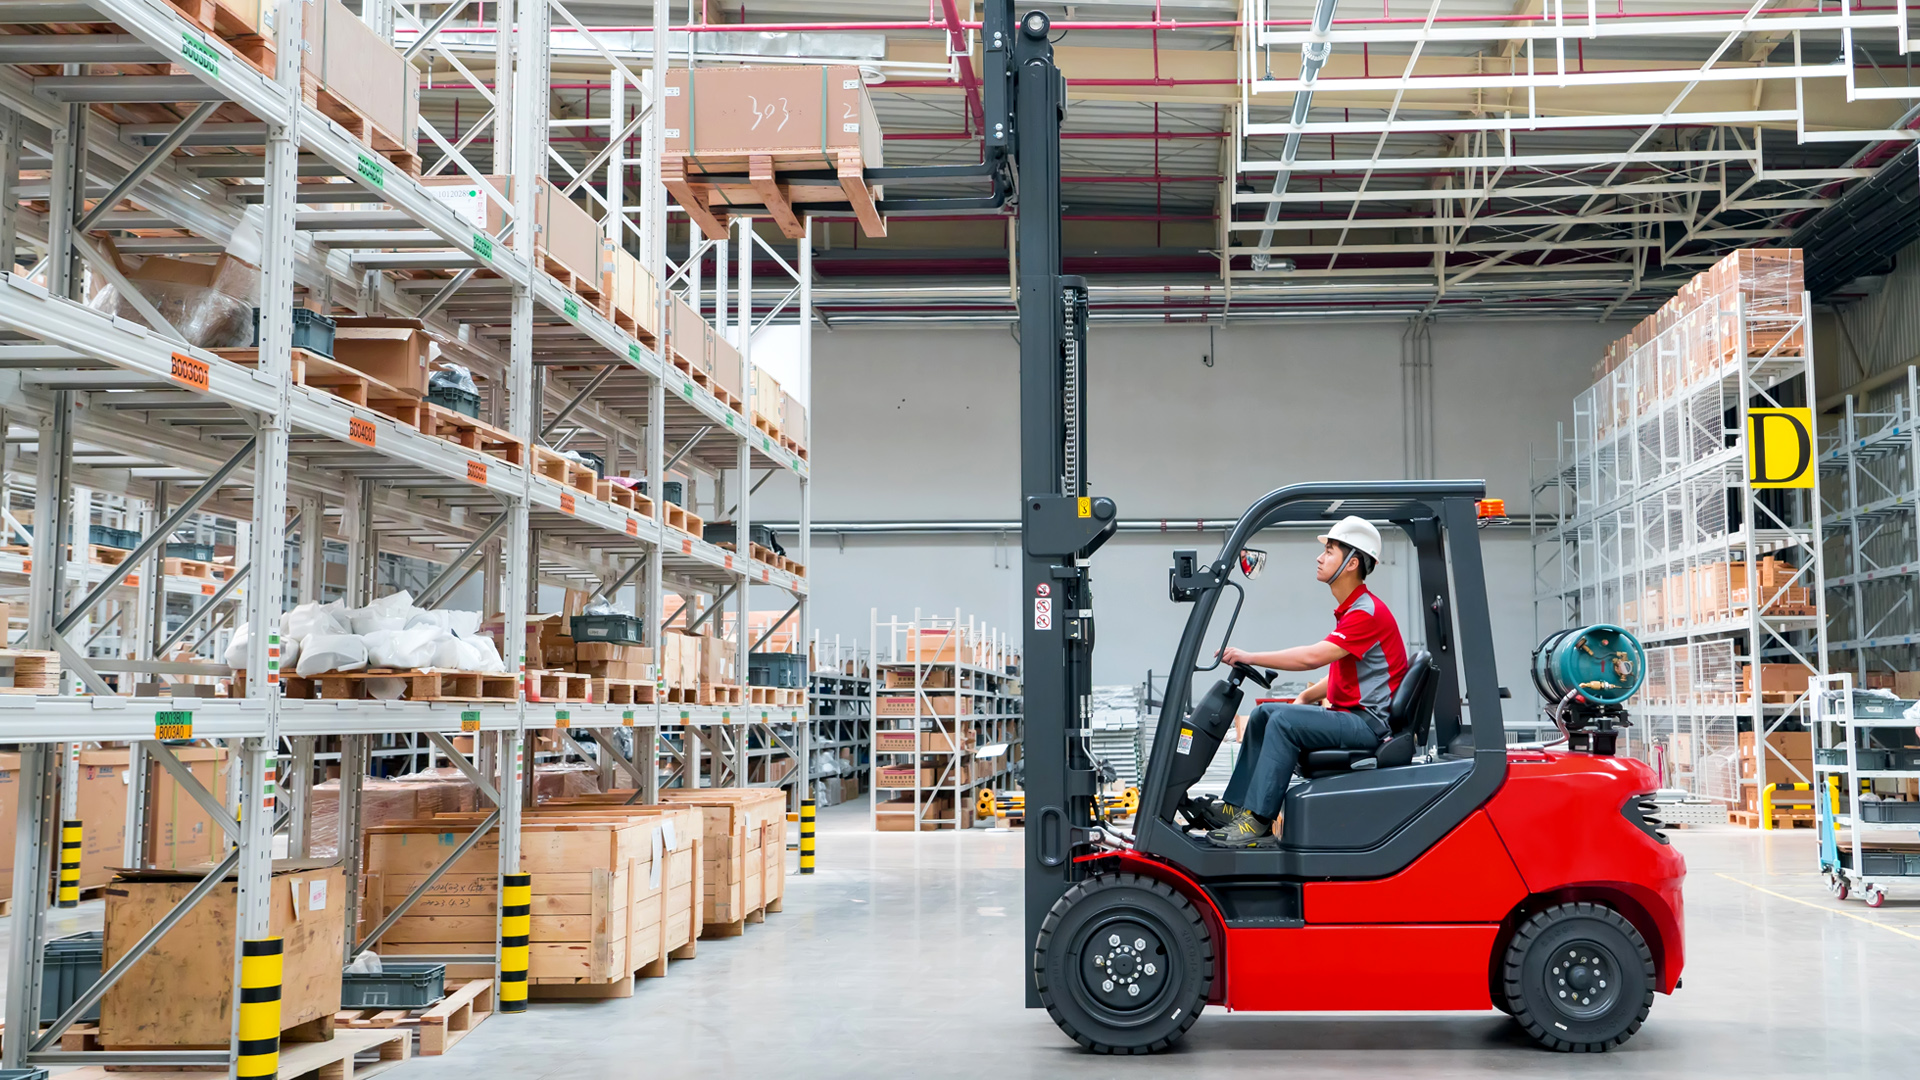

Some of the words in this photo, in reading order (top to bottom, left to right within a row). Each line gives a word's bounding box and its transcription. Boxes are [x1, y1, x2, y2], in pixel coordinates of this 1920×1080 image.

[748, 95, 789, 133] 303
[843, 102, 858, 119] 2
[171, 356, 208, 386] B003C01
[350, 420, 375, 442] B004C01
[1747, 412, 1811, 483] D
